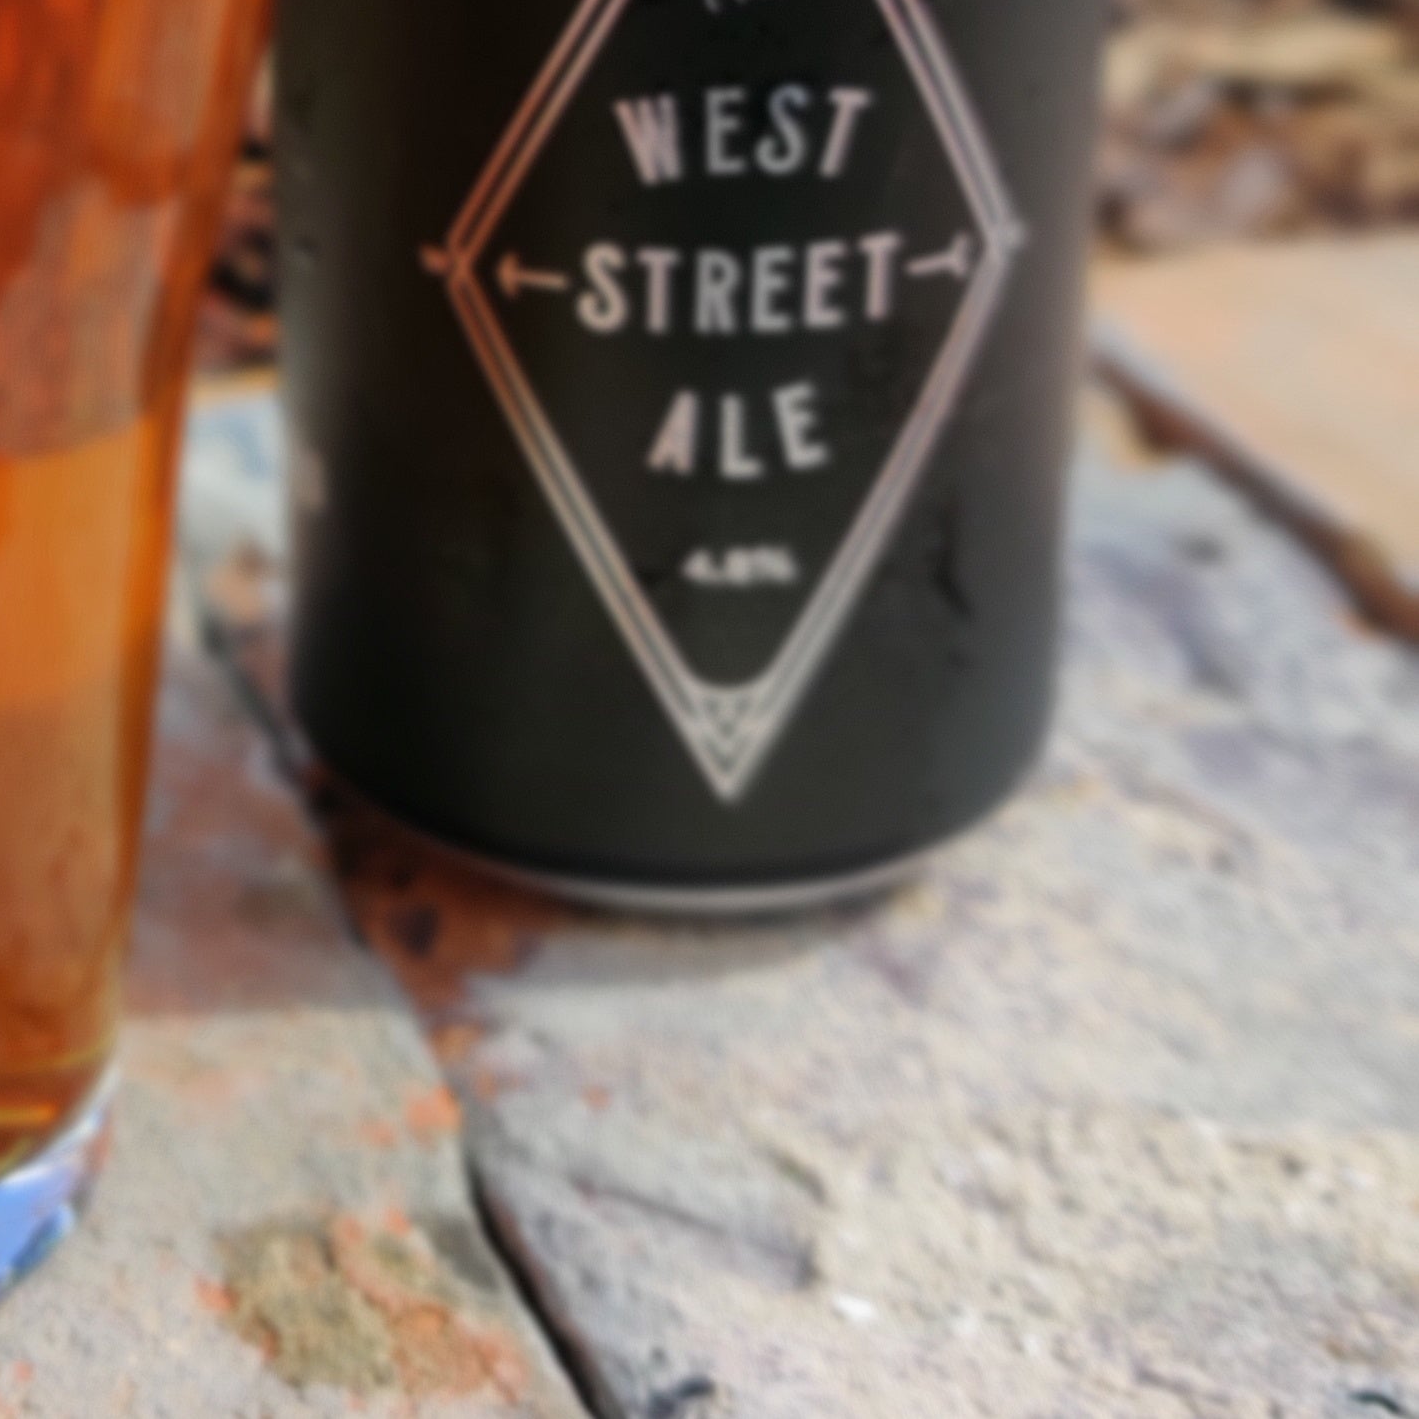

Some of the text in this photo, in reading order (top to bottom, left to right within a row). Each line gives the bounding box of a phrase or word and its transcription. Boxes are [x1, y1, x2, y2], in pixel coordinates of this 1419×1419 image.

[613, 84, 873, 186] WEST
[576, 230, 901, 336] STREET
[646, 382, 829, 478] ALE
